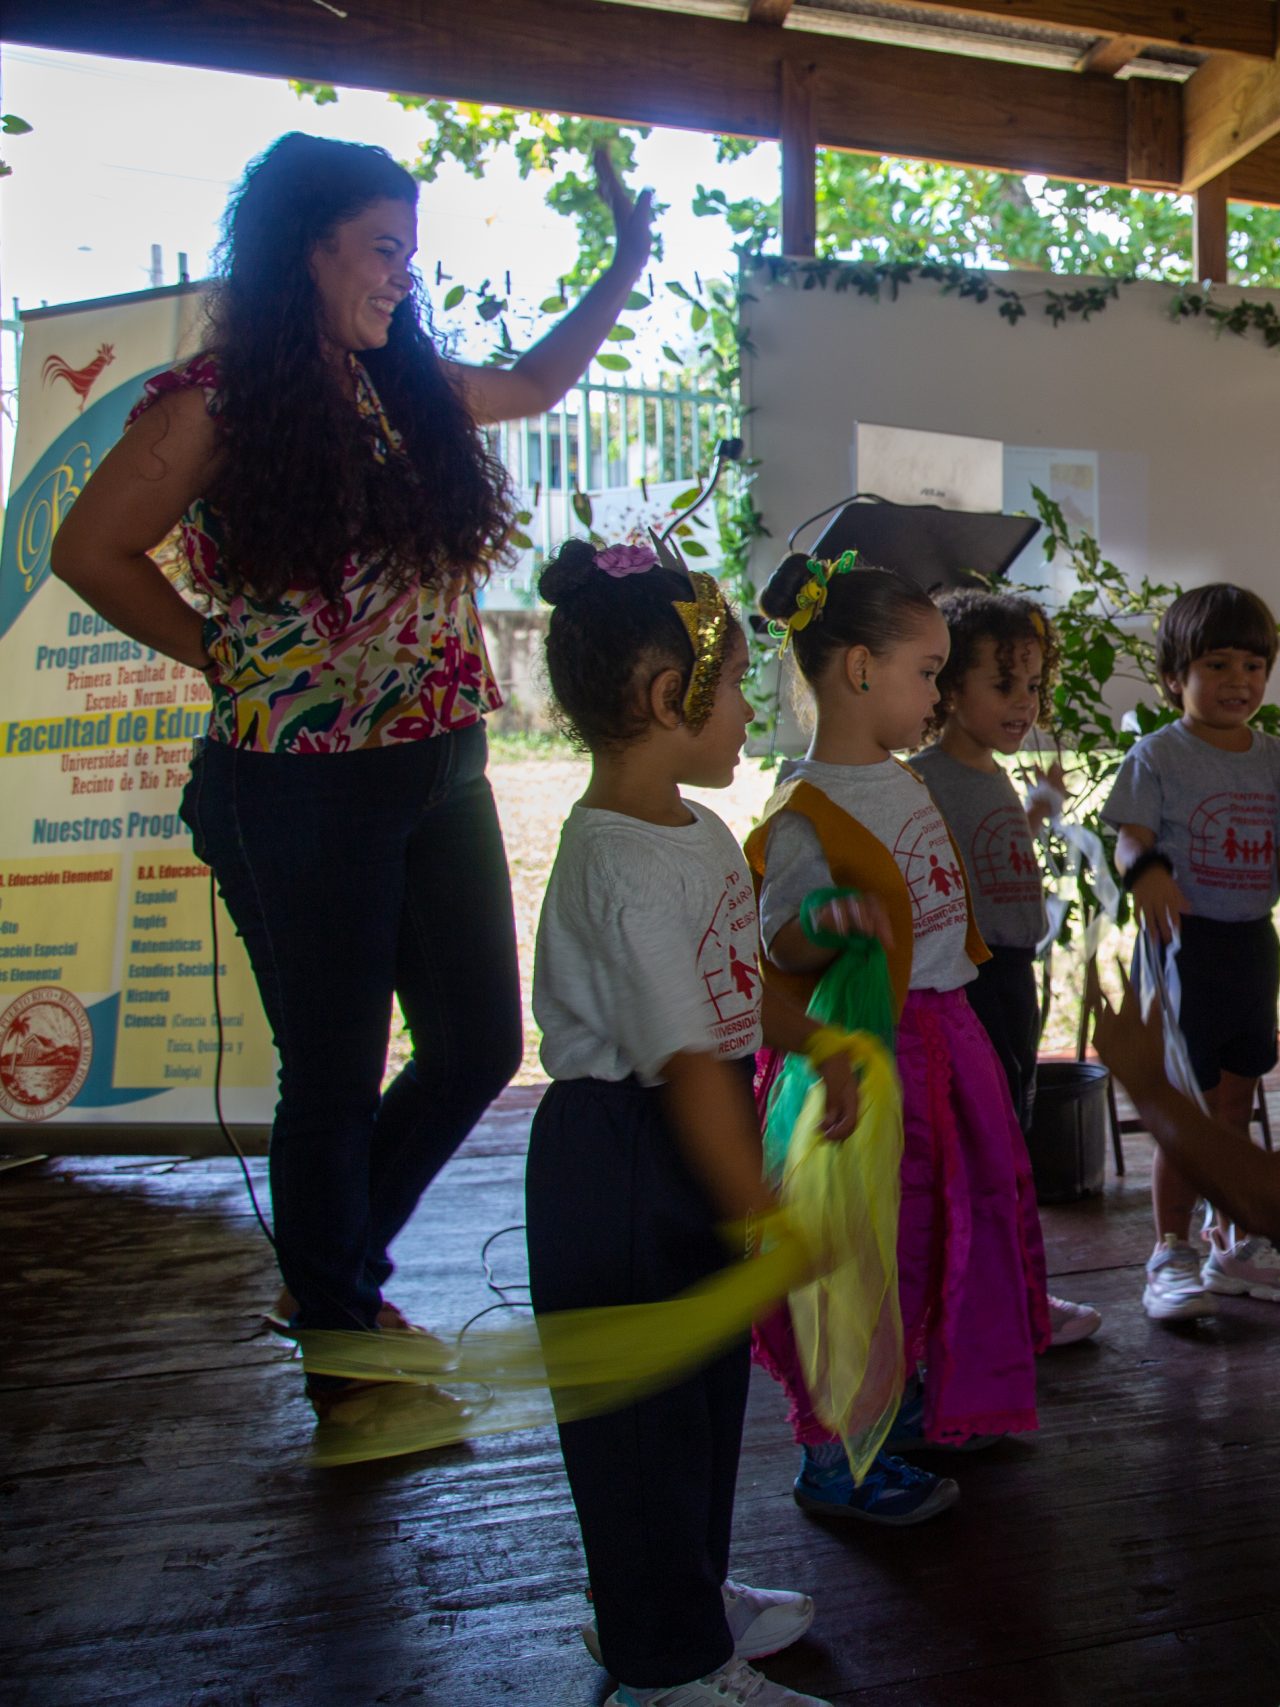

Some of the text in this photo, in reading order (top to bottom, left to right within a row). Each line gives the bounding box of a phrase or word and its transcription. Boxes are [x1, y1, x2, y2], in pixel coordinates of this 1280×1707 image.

[36, 640, 143, 670] Programas
[66, 671, 112, 690] Primera
[117, 662, 167, 685] Facultad
[171, 664, 186, 679] de
[85, 690, 128, 712] Escuela
[134, 685, 177, 706] Normal
[6, 713, 111, 753] Facultad
[116, 710, 148, 743] de
[61, 752, 129, 772] Universidad
[134, 747, 149, 767] de
[72, 776, 114, 795] Recinto
[120, 772, 134, 792] de
[33, 818, 123, 844] Nuestros
[8, 872, 60, 887] Educación
[62, 868, 114, 884] Elemental
[158, 863, 211, 879] Educació
[134, 888, 178, 905] Español
[0, 942, 78, 958] cación Especial
[130, 938, 202, 954] Matemáticas
[10, 967, 62, 982] Elemental
[128, 964, 175, 979] Estudios
[126, 988, 170, 1004] Historia
[124, 1012, 167, 1028] Ciencia
